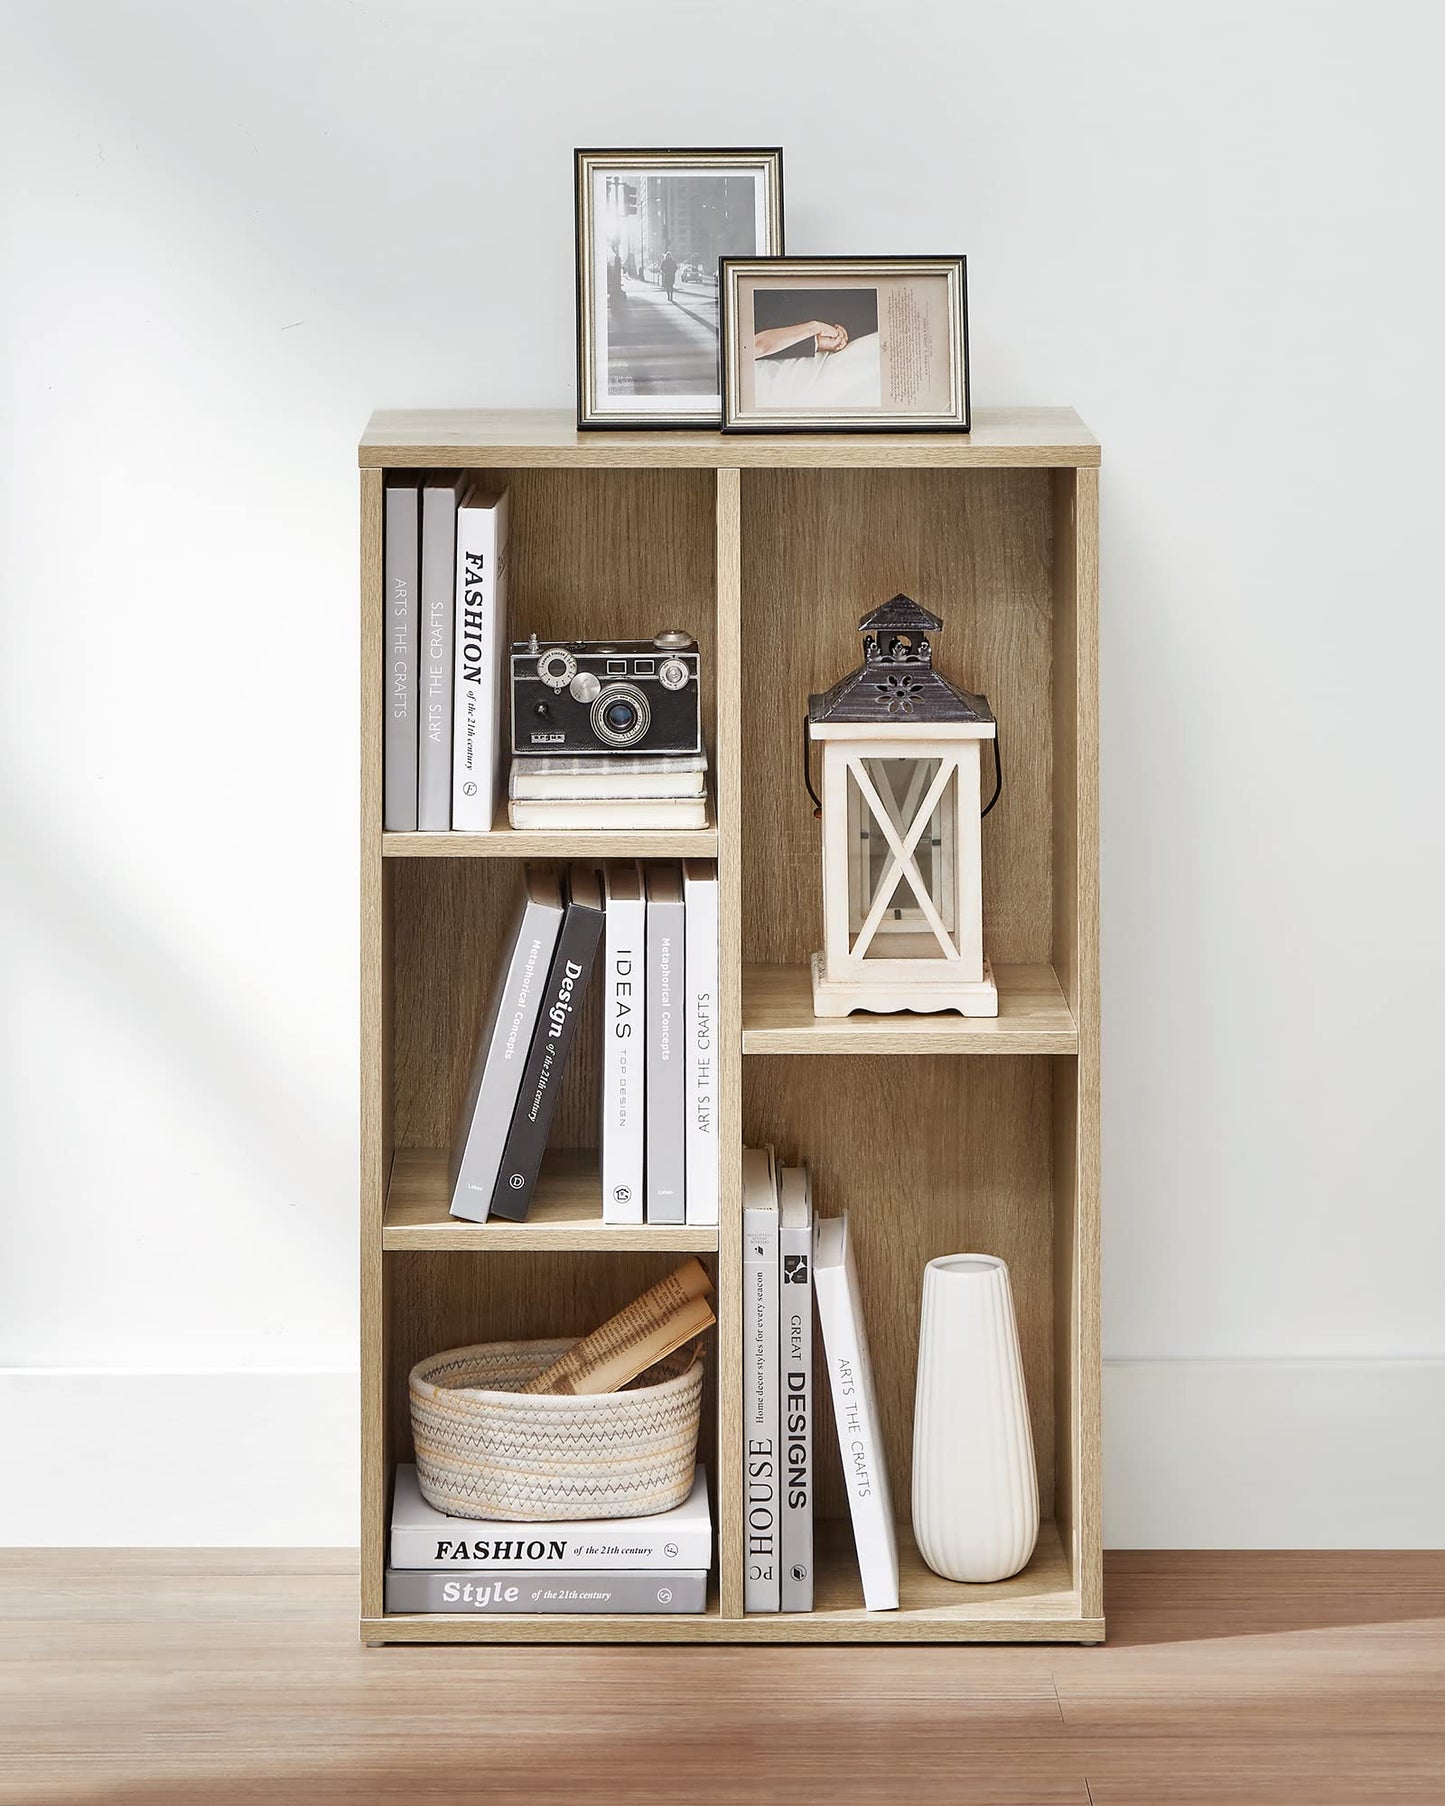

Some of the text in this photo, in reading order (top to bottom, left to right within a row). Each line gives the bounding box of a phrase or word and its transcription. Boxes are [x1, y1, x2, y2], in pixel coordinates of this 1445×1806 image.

[393, 578, 408, 720] ARTS THE CRAFTS
[428, 601, 444, 744] ARTS THE CRAFTS
[463, 550, 484, 771] FASHION of the 21th century
[504, 938, 542, 1060] Metaphorical Concepts
[528, 959, 583, 1123] Design of the 21th century
[615, 950, 632, 1039] IDEAS
[659, 937, 672, 1061] Metaphorical Concepts
[619, 1048, 627, 1127] TOP DESIGN
[697, 993, 711, 1134] ARTS THE CRAFTS
[754, 1328, 763, 1342] for
[755, 1344, 765, 1370] styles
[756, 1303, 765, 1328] every
[755, 1371, 764, 1396] decor
[755, 1397, 764, 1424] Home
[787, 1314, 807, 1510] GREAT DESIGNS
[837, 1358, 872, 1498] ARTS THE CRAFTS
[748, 1438, 774, 1557] HOUSE
[434, 1540, 653, 1560] FASHION of the 21th century
[442, 1581, 612, 1608] Style of the 21th century
[749, 1565, 773, 1581] PC
